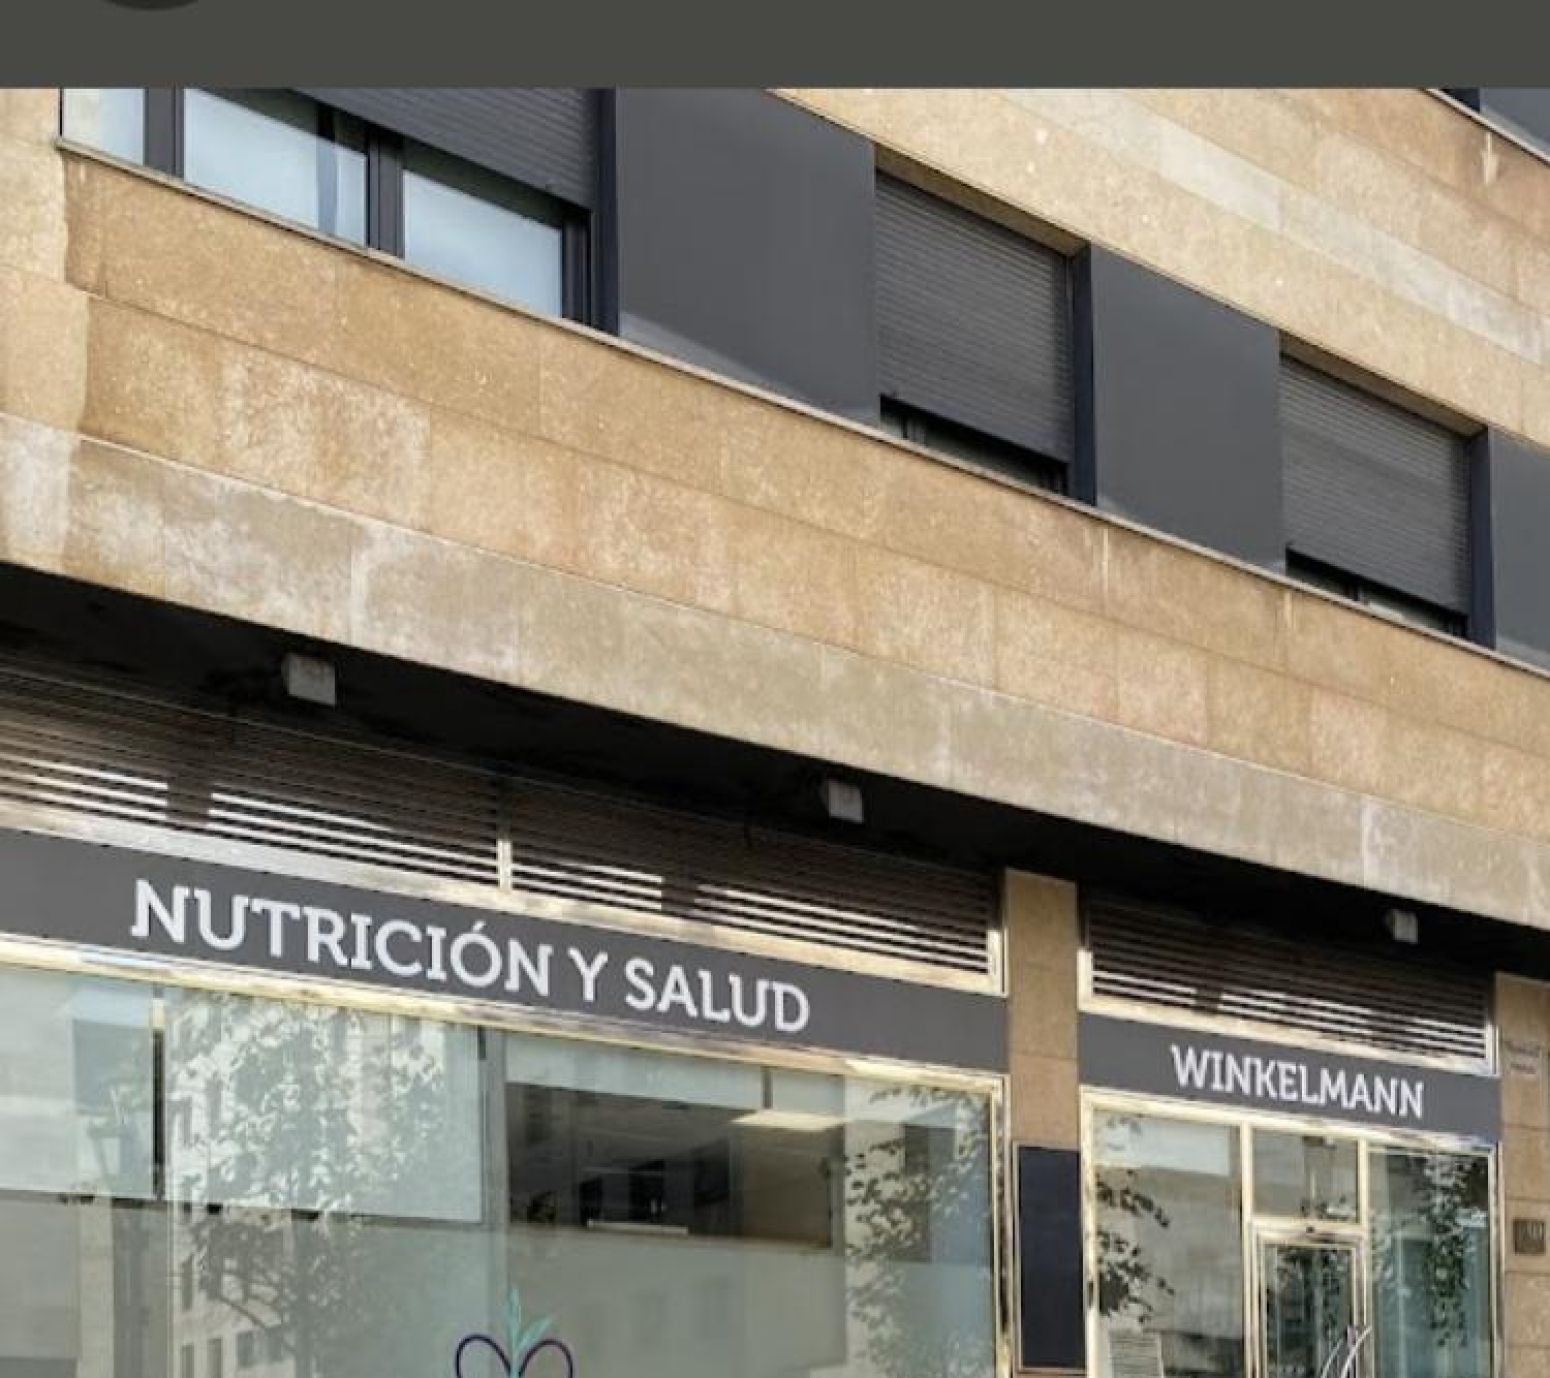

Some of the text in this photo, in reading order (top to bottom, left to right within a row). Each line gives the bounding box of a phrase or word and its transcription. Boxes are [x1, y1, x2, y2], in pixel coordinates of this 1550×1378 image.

[129, 878, 812, 1033] NUTRICIÓN Y SALUD
[1170, 1044, 1426, 1119] WINKELMANN
